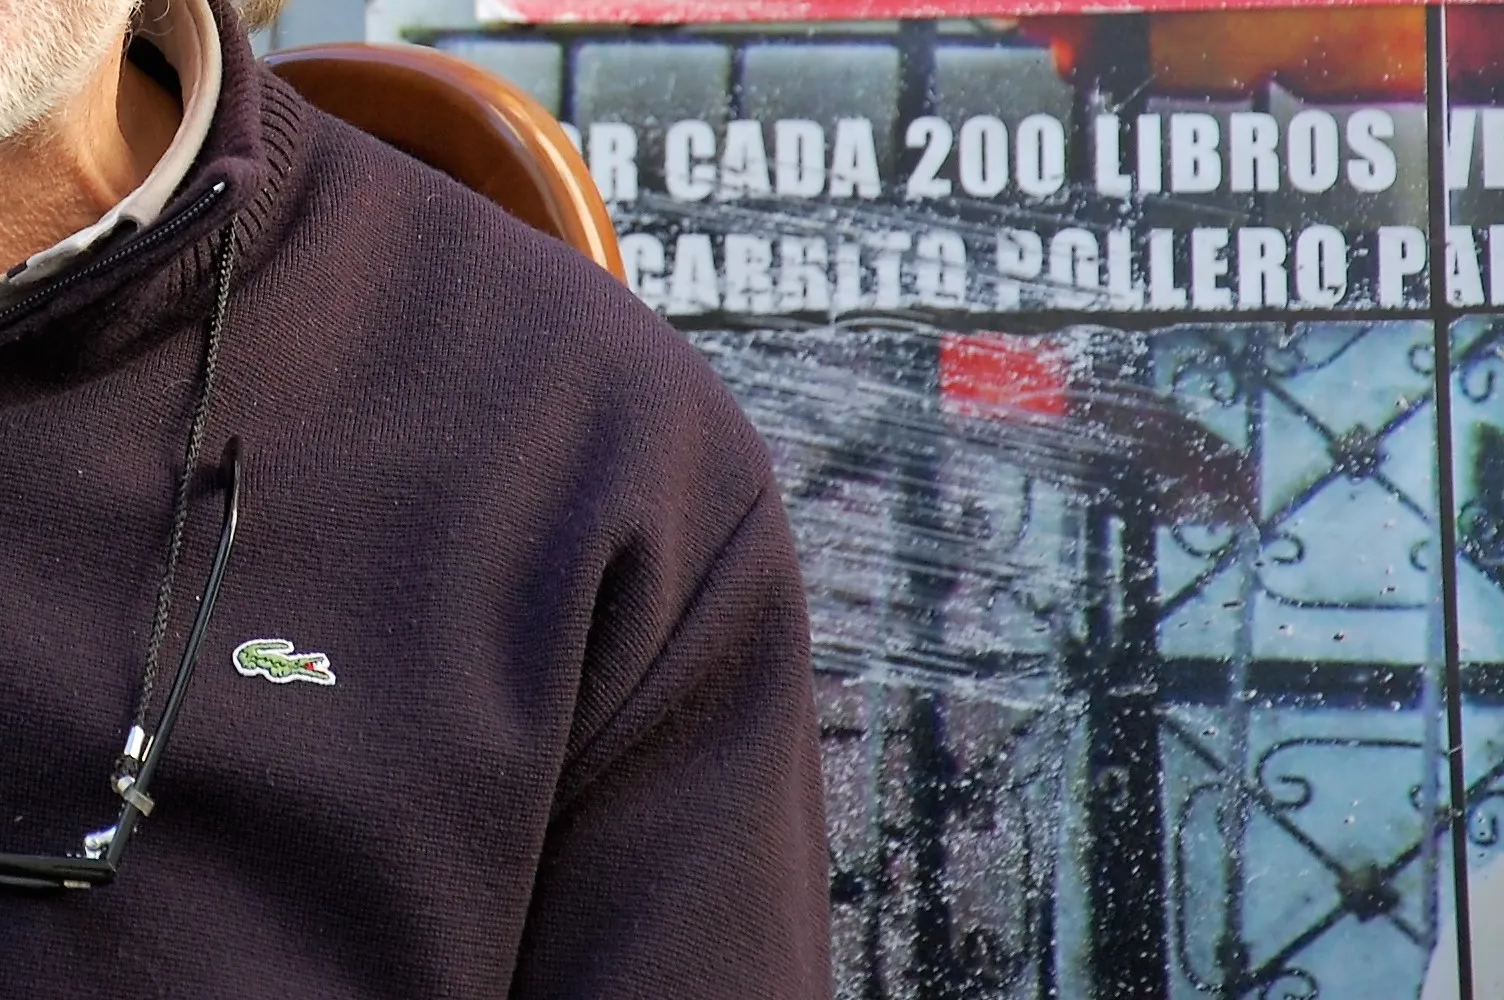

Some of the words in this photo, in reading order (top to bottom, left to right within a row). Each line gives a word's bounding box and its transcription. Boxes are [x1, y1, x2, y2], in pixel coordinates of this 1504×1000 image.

[664, 117, 883, 201] CADA
[905, 113, 1066, 198] 200
[1095, 108, 1398, 197] LIBROS
